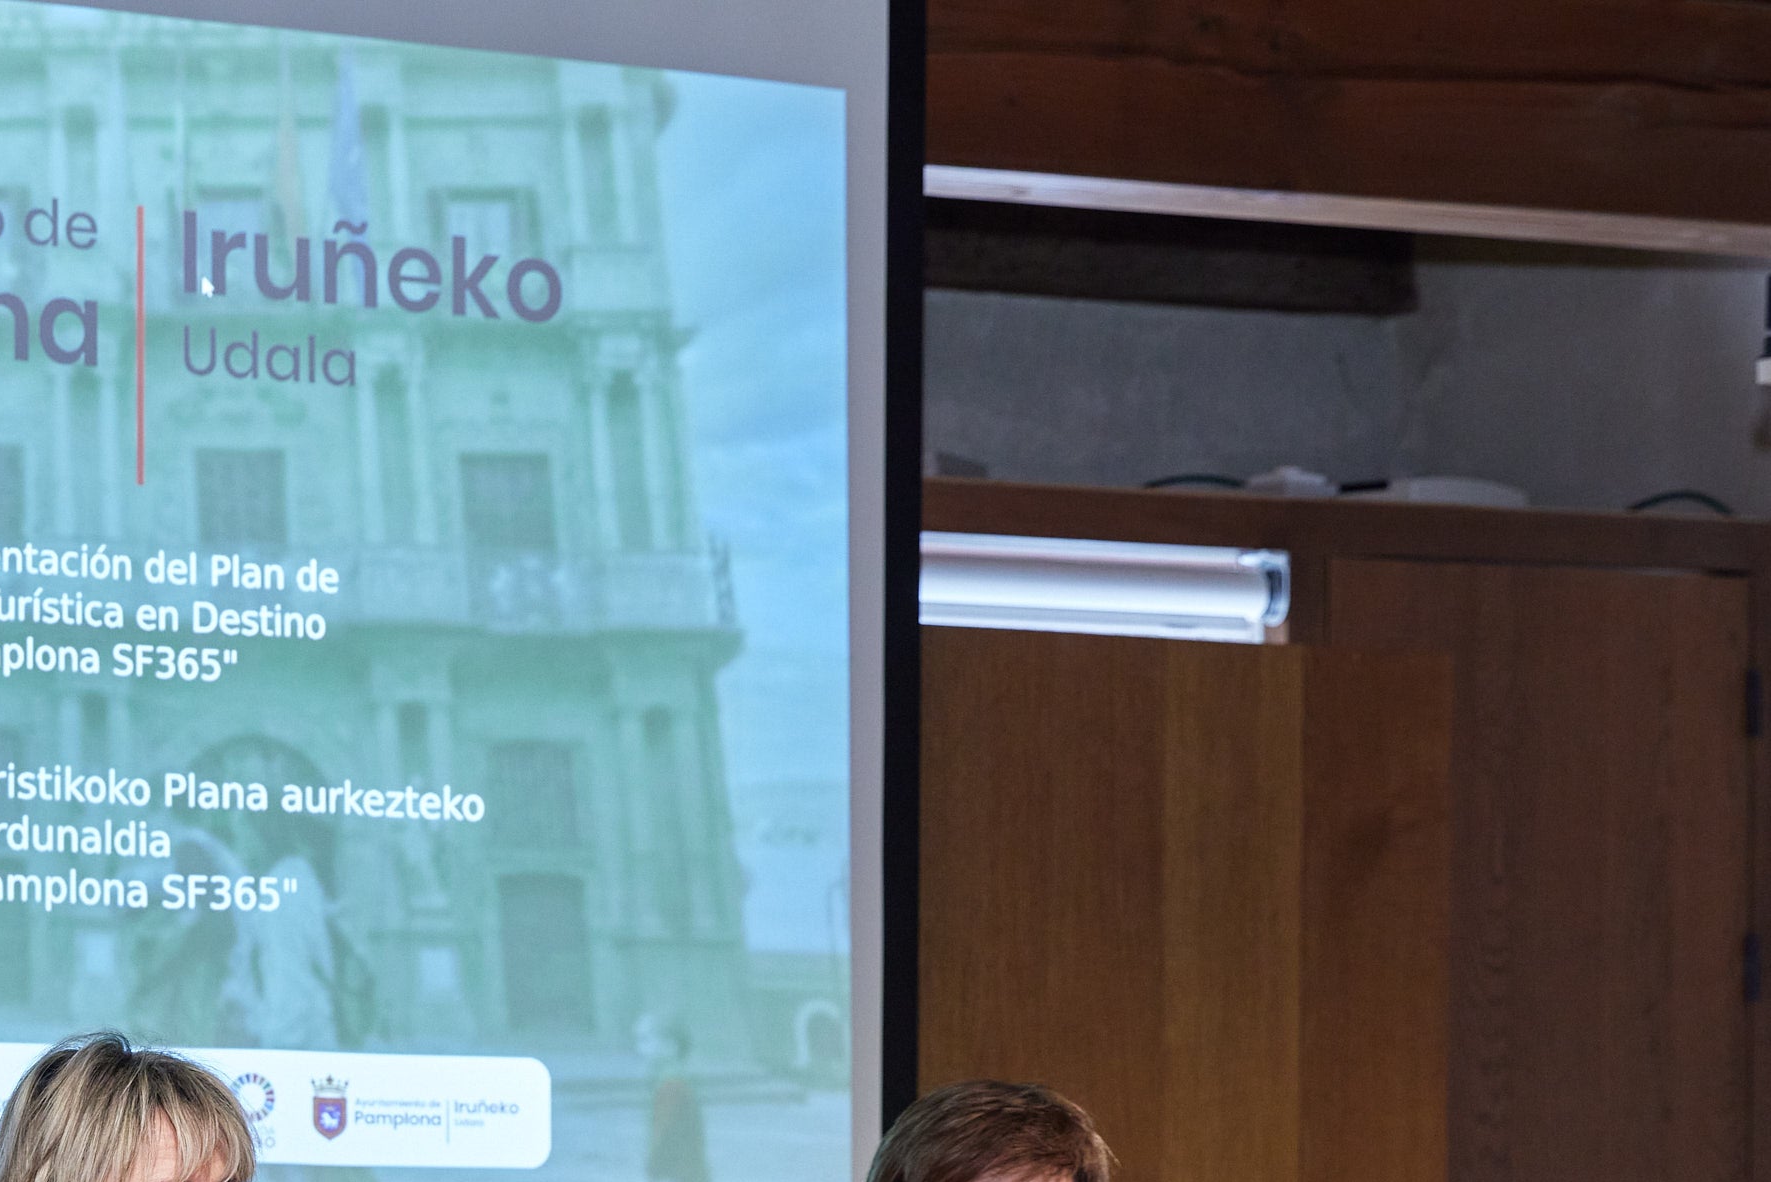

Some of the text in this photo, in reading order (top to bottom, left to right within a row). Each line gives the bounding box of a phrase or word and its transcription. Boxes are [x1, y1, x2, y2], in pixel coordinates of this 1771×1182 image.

[24, 197, 99, 251] de
[181, 209, 563, 323] Iruñeko
[182, 326, 358, 388] Udala
[144, 549, 197, 586] del
[211, 552, 287, 592] Plan
[296, 557, 339, 593] de
[136, 603, 179, 631] en
[193, 601, 326, 641] Destino
[112, 644, 237, 682] SF365"
[164, 772, 268, 811] Plana
[281, 780, 485, 822] aurkezteko
[161, 874, 298, 912] SF365"
[355, 1111, 441, 1129] Pamplona
[454, 1099, 519, 1115] Iruñeko
